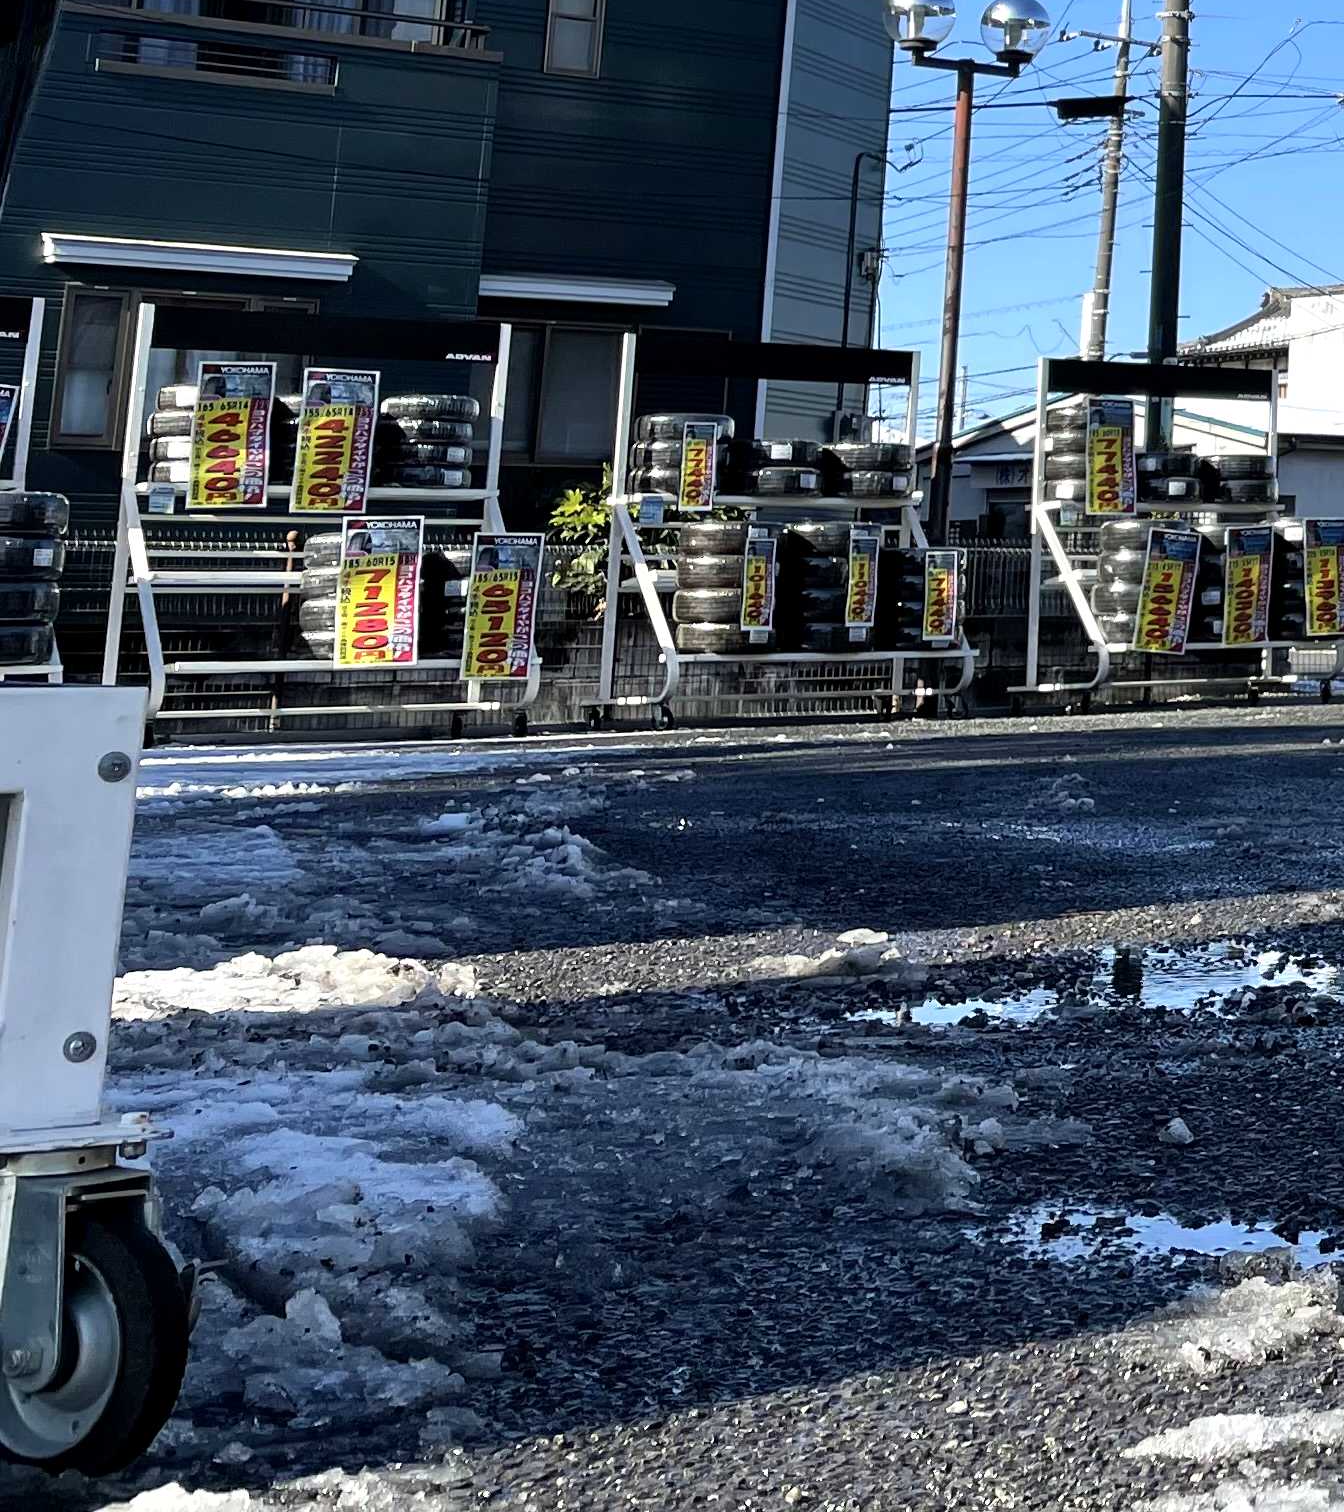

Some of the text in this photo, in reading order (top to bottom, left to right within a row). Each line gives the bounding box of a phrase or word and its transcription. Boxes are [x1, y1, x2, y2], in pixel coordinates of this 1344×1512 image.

[446, 353, 492, 361] ADVAN
[220, 365, 270, 375] YOKOHAMA
[325, 373, 373, 383] YOKOHAMA
[366, 521, 418, 529] YOKOHAMA
[494, 537, 538, 546] YOKOHAMA
